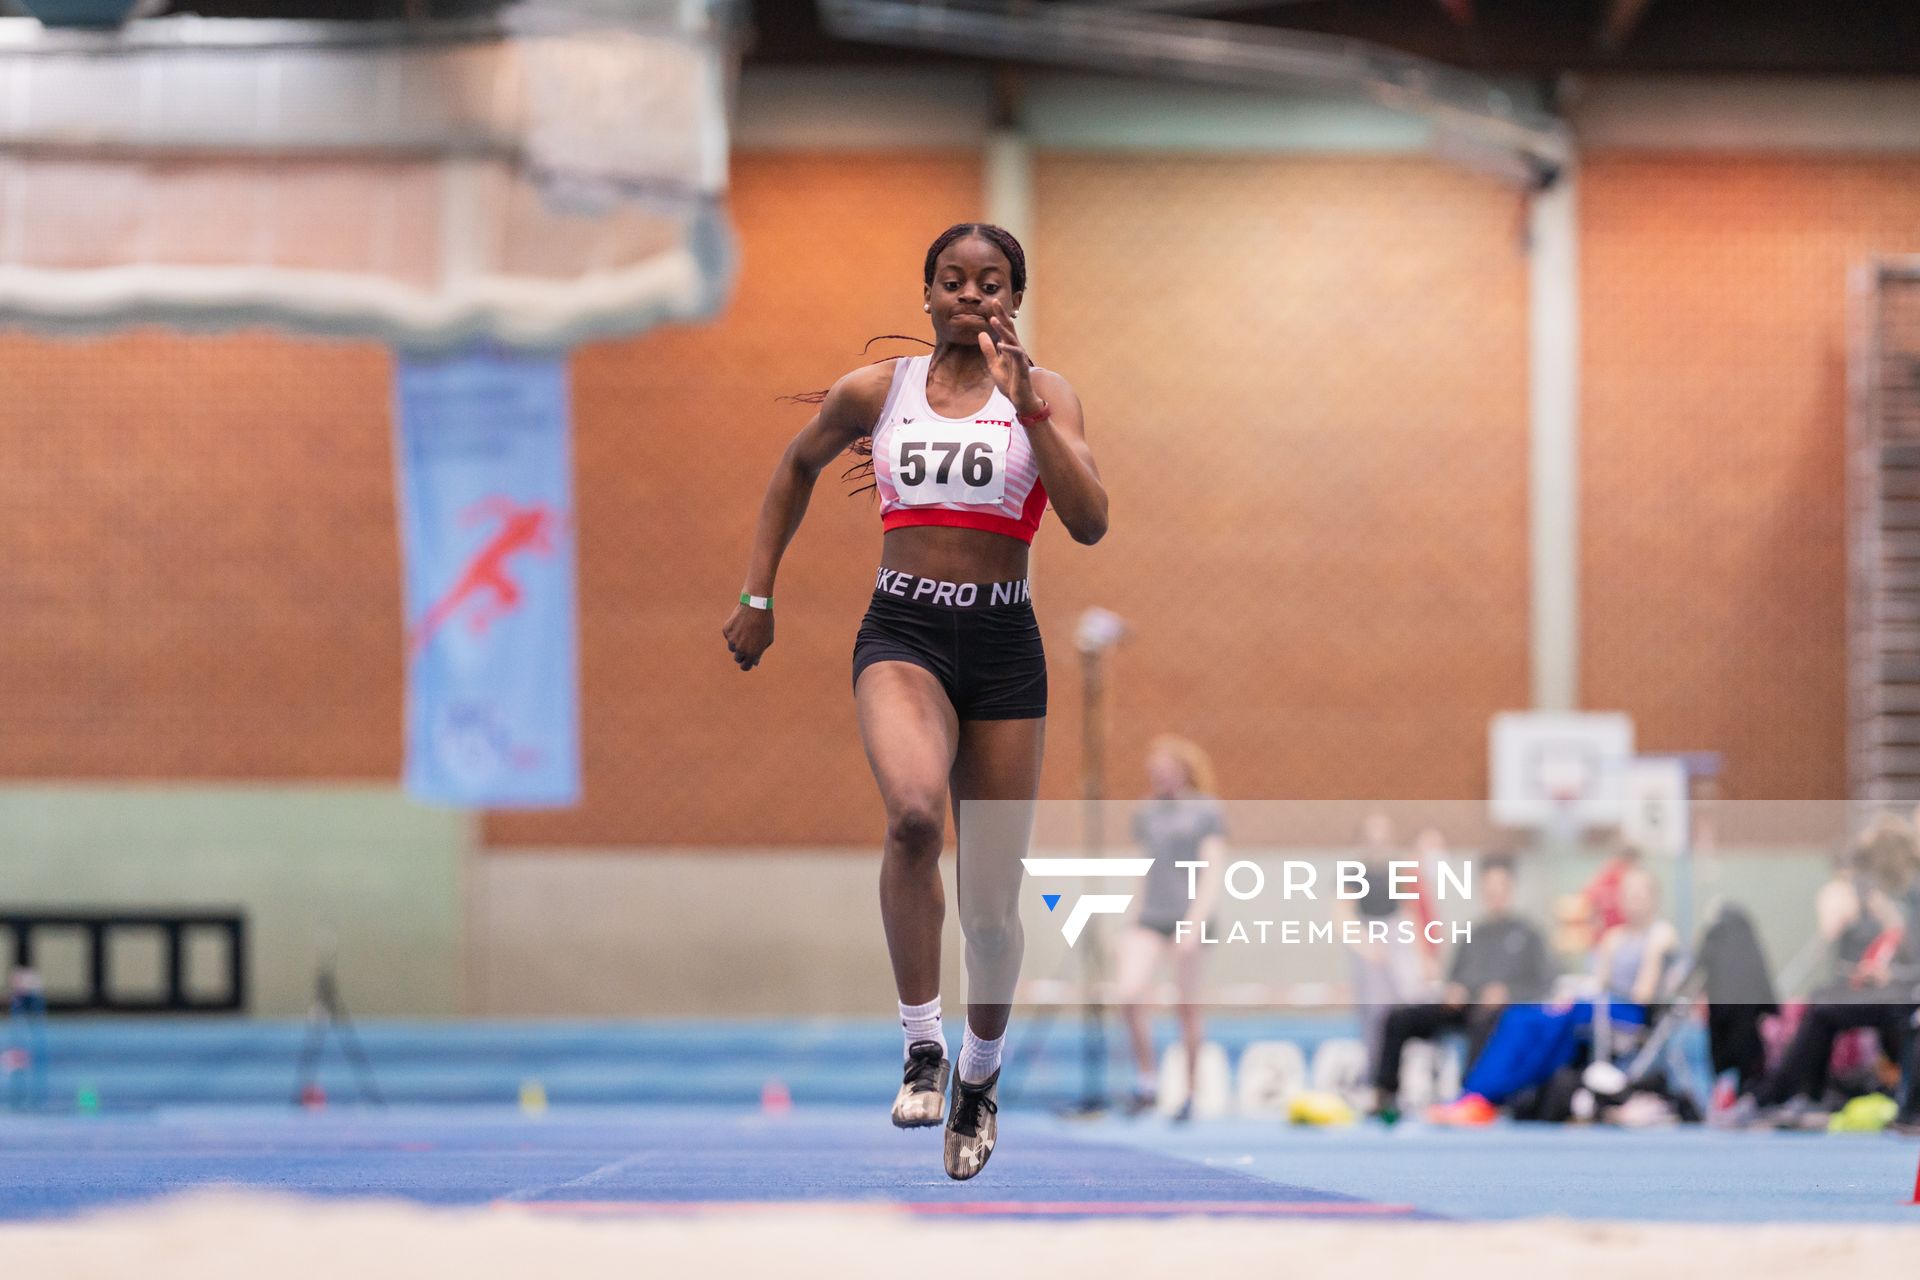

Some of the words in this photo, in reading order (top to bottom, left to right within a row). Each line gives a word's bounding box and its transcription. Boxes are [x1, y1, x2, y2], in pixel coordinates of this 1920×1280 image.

[900, 442, 993, 487] 576
[876, 567, 913, 596] IKE
[912, 578, 978, 607] PRO
